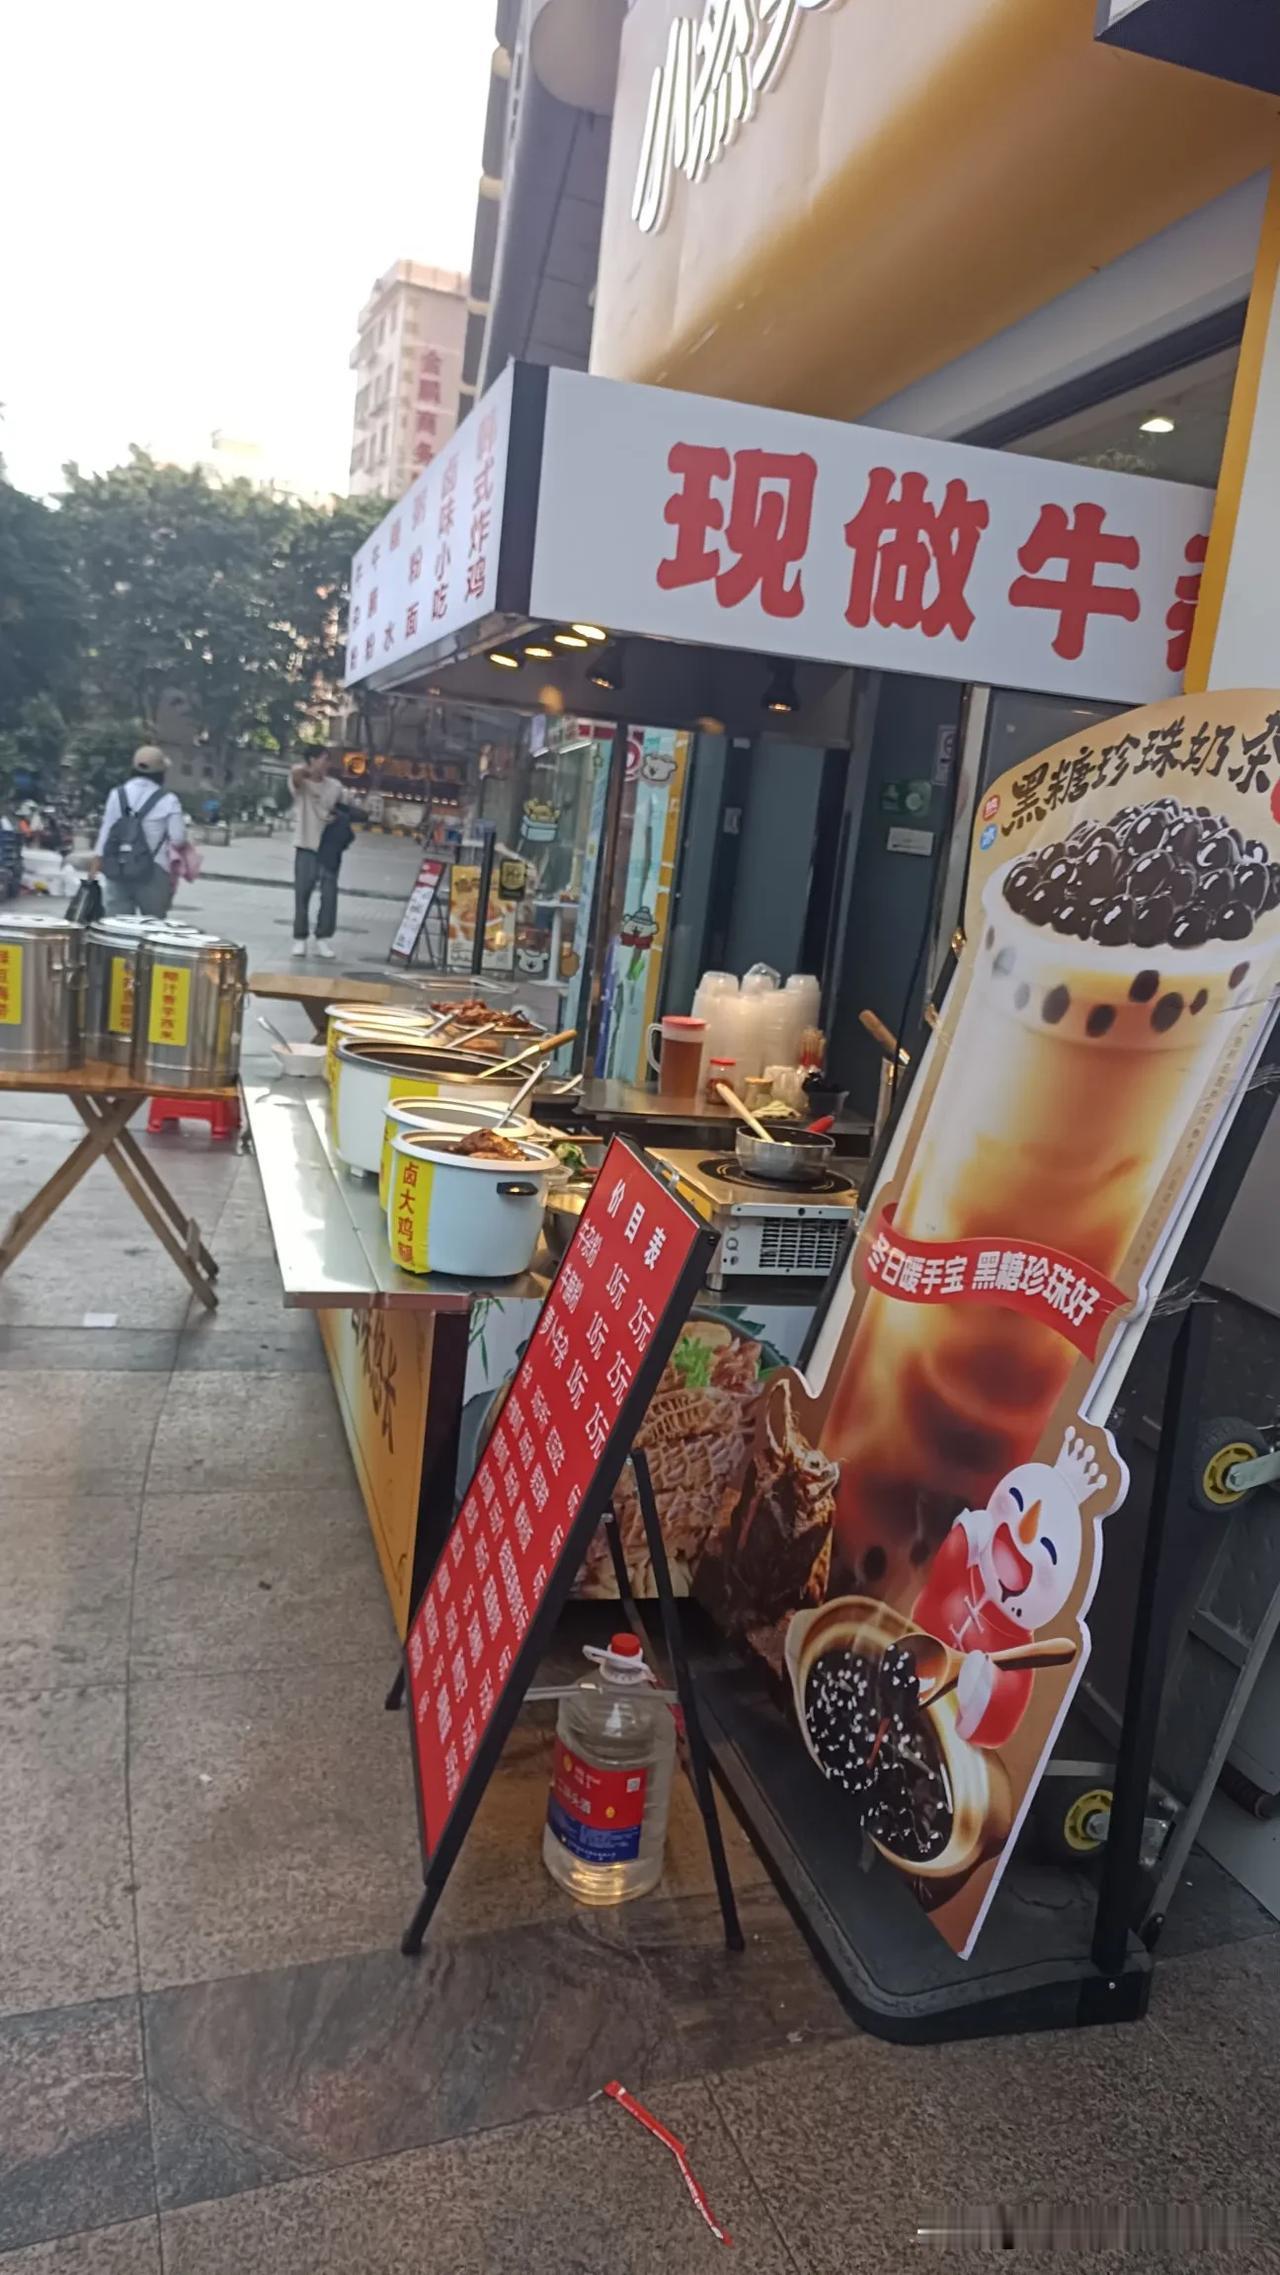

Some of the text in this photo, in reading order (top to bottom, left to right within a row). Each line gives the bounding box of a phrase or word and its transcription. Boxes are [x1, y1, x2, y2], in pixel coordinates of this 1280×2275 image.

[606, 1178, 667, 1271] 价目表
[605, 1262, 630, 1311] 18元
[627, 1298, 656, 1353] 25元
[971, 1250, 1101, 1327] 黑糖珍珠好
[585, 1311, 610, 1361] 18元
[606, 1350, 633, 1407] 25元
[566, 1359, 589, 1411] 18元
[584, 1402, 610, 1460] 25元
